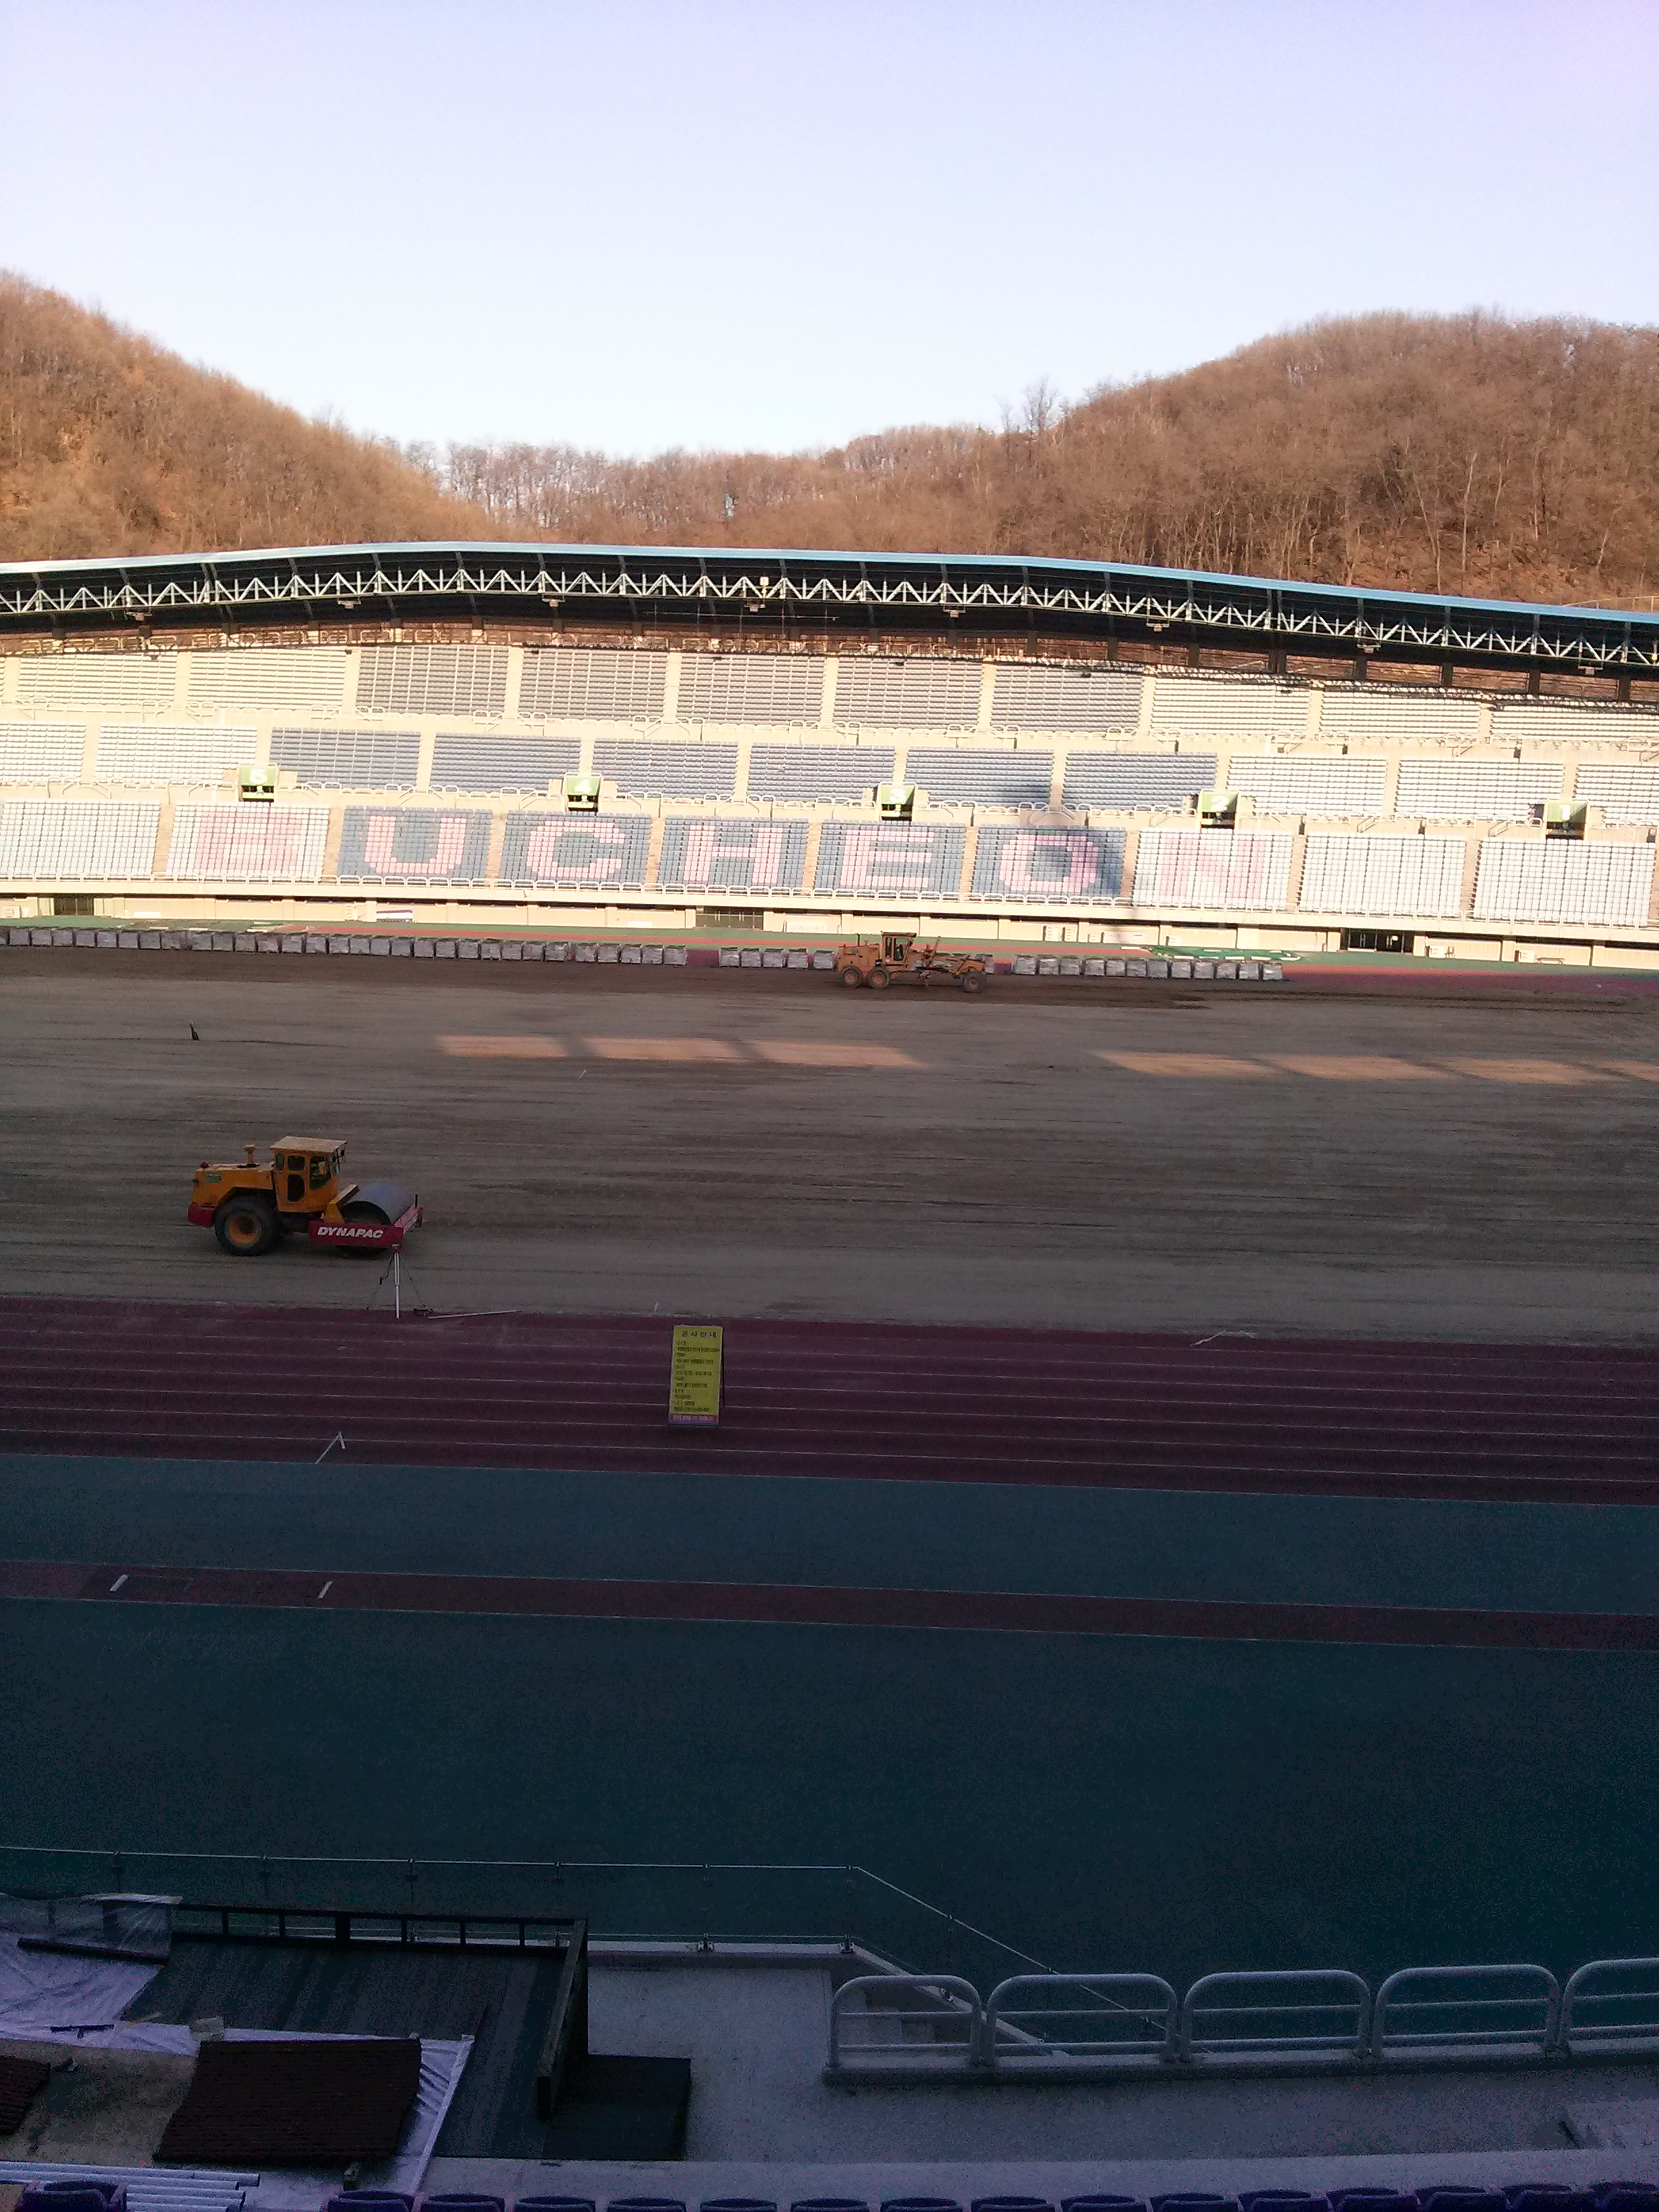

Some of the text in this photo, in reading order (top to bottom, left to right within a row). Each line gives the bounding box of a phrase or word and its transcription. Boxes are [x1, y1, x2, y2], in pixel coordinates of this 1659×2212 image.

[574, 779, 592, 794] 4
[889, 787, 905, 802] 3
[1211, 795, 1229, 810] 2
[317, 1226, 384, 1239] DYNAPAC
